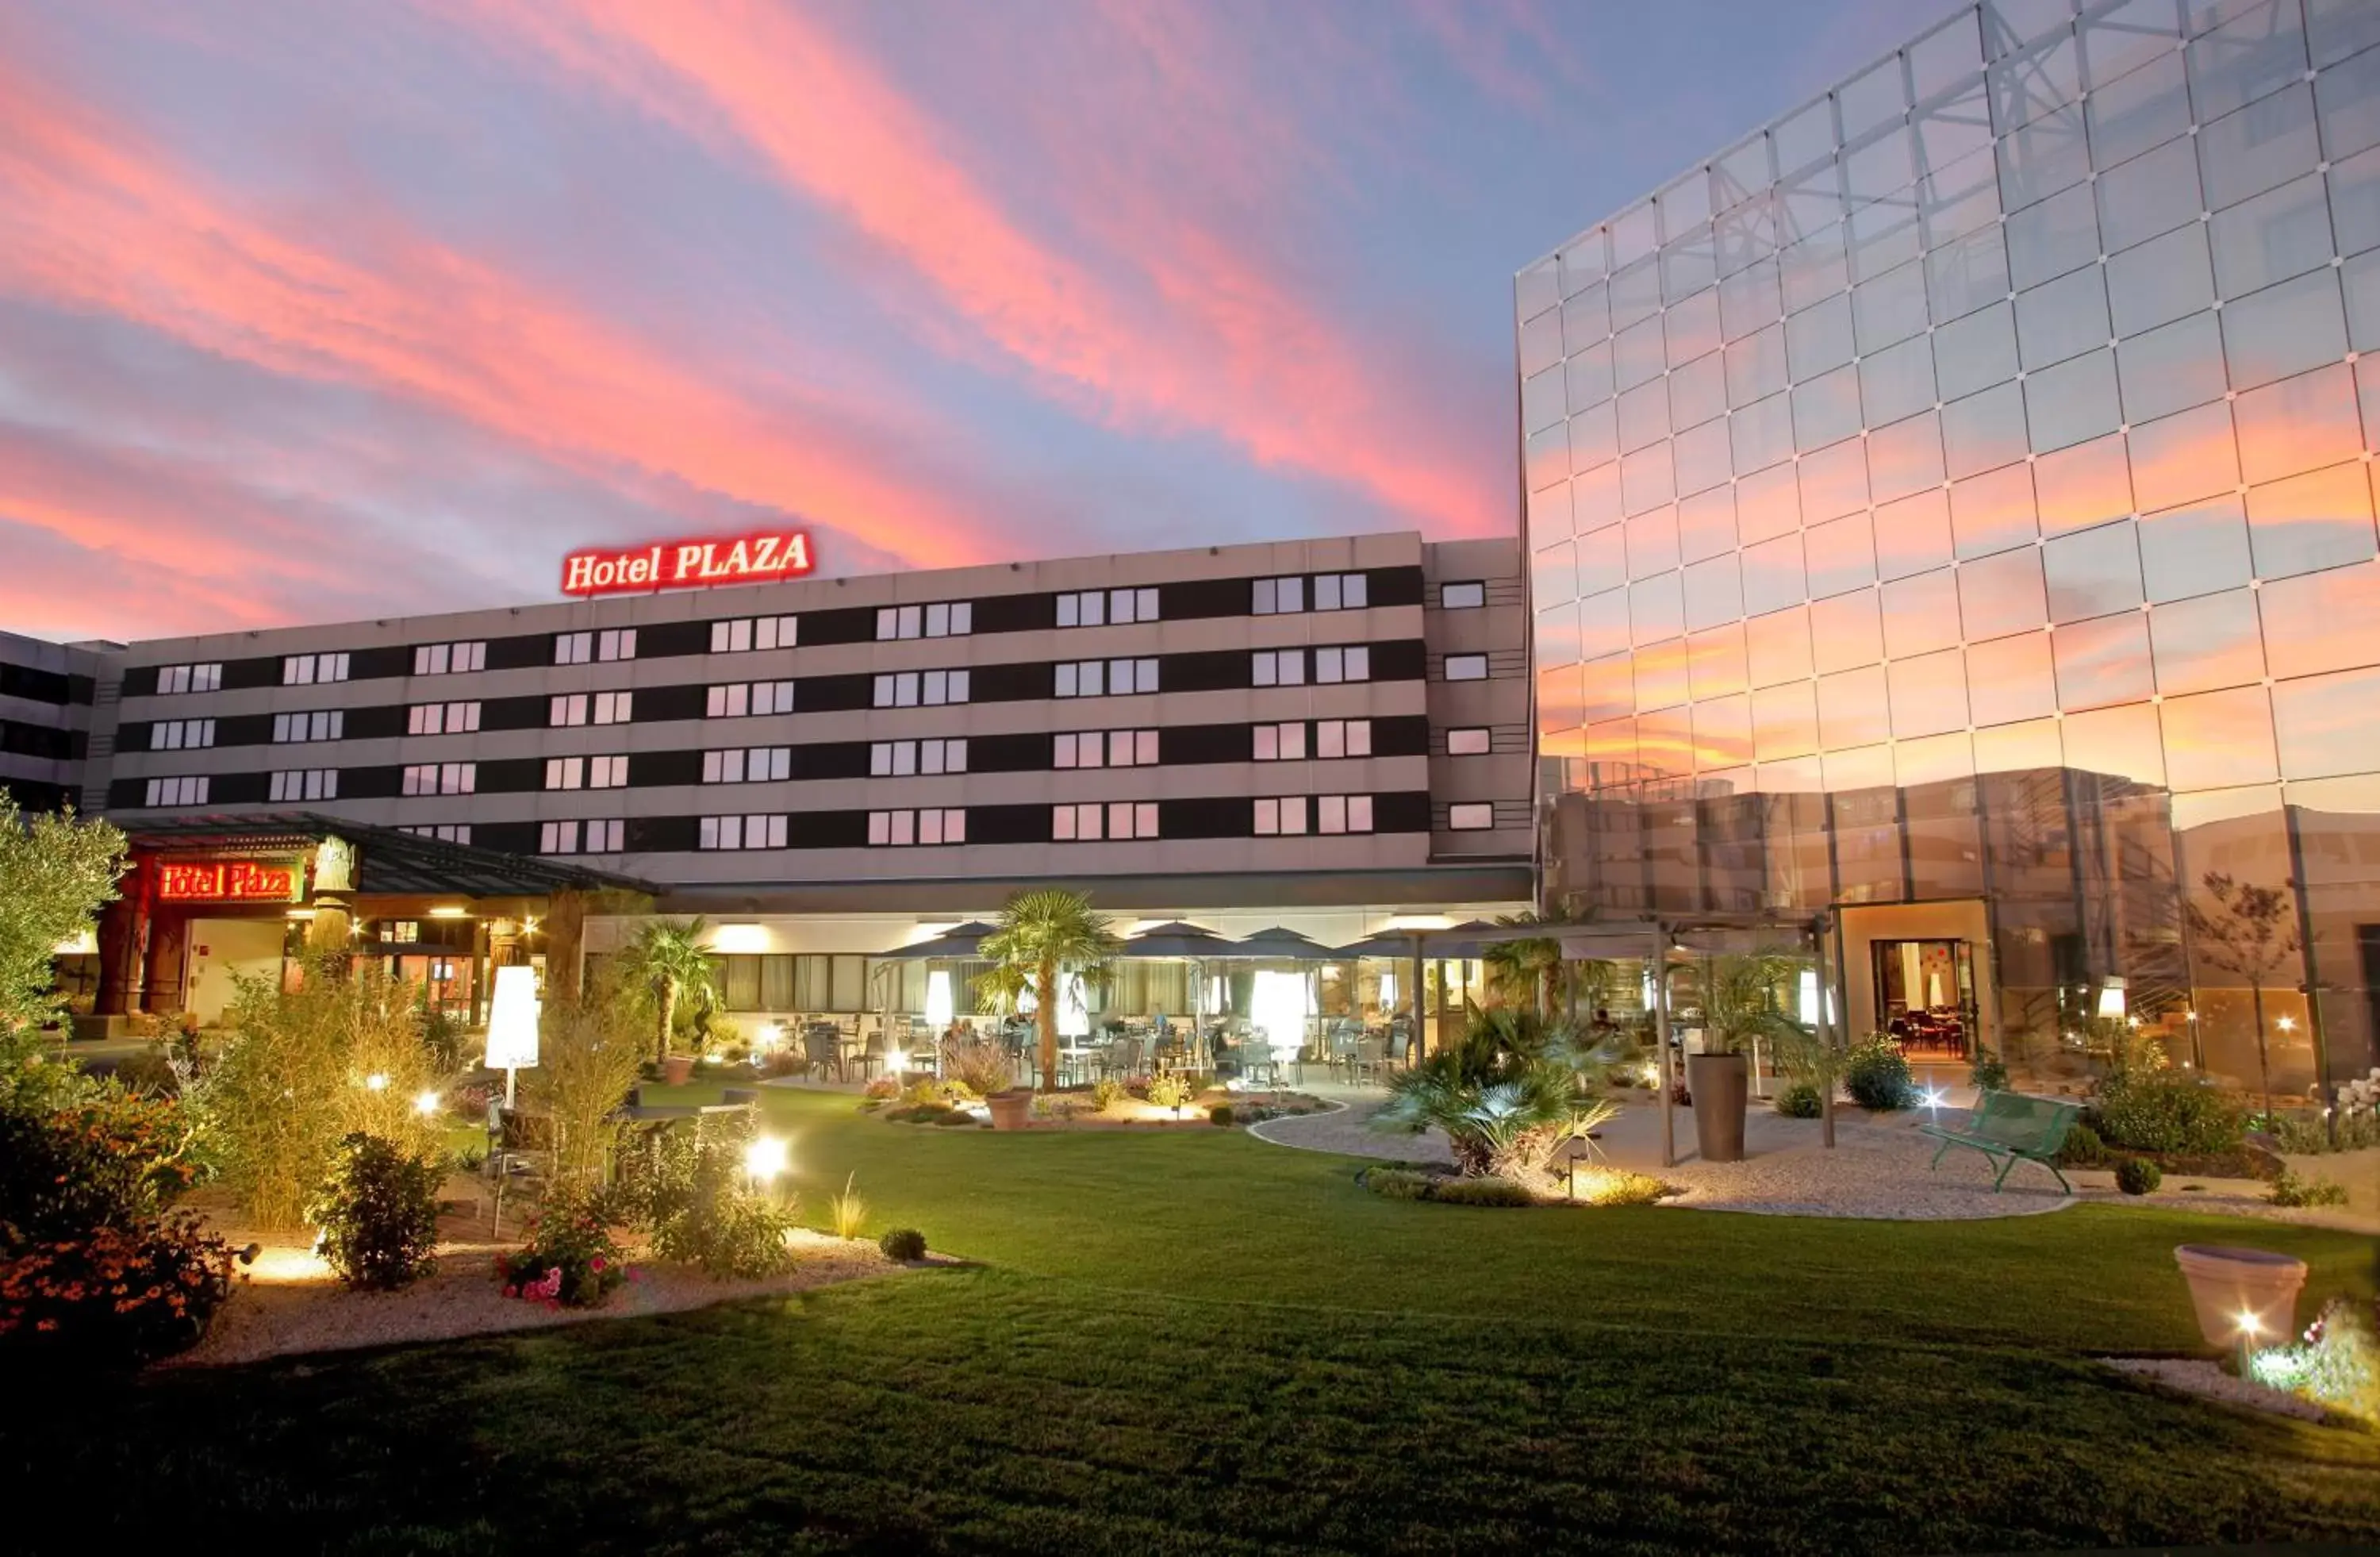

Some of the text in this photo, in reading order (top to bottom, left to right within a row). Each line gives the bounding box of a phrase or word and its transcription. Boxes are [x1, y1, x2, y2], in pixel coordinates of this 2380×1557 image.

[565, 533, 808, 590] Hotel PLAZA
[230, 864, 294, 897] Plaza
